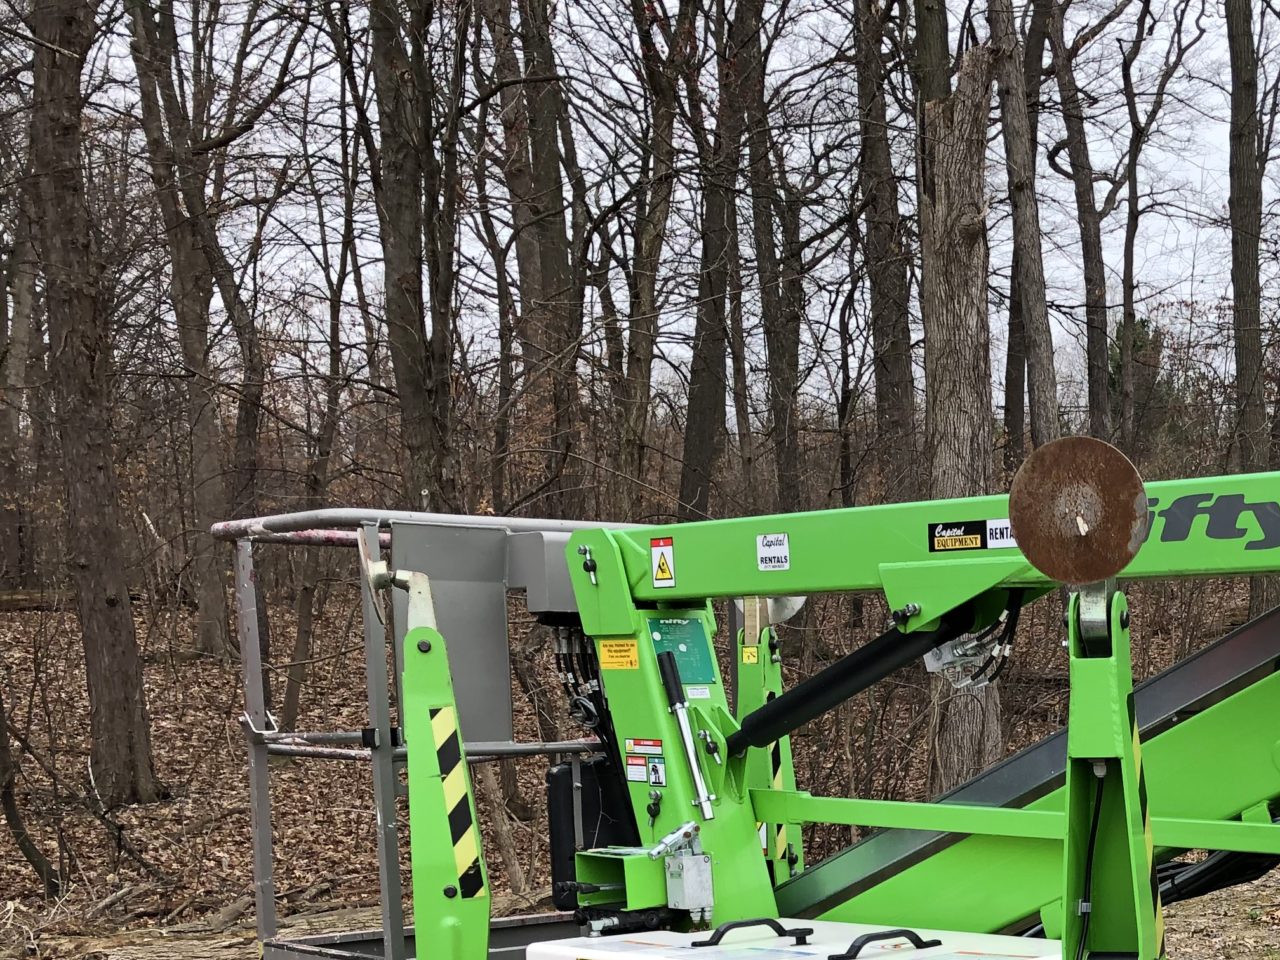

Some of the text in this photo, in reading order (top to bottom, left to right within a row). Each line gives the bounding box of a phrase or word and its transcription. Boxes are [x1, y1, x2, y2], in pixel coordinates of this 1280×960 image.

[935, 524, 964, 537] Capital
[989, 527, 1015, 540] RENTA
[762, 533, 785, 548] Capital
[936, 537, 979, 548] EQUIPMENT
[760, 556, 788, 564] RENTALS
